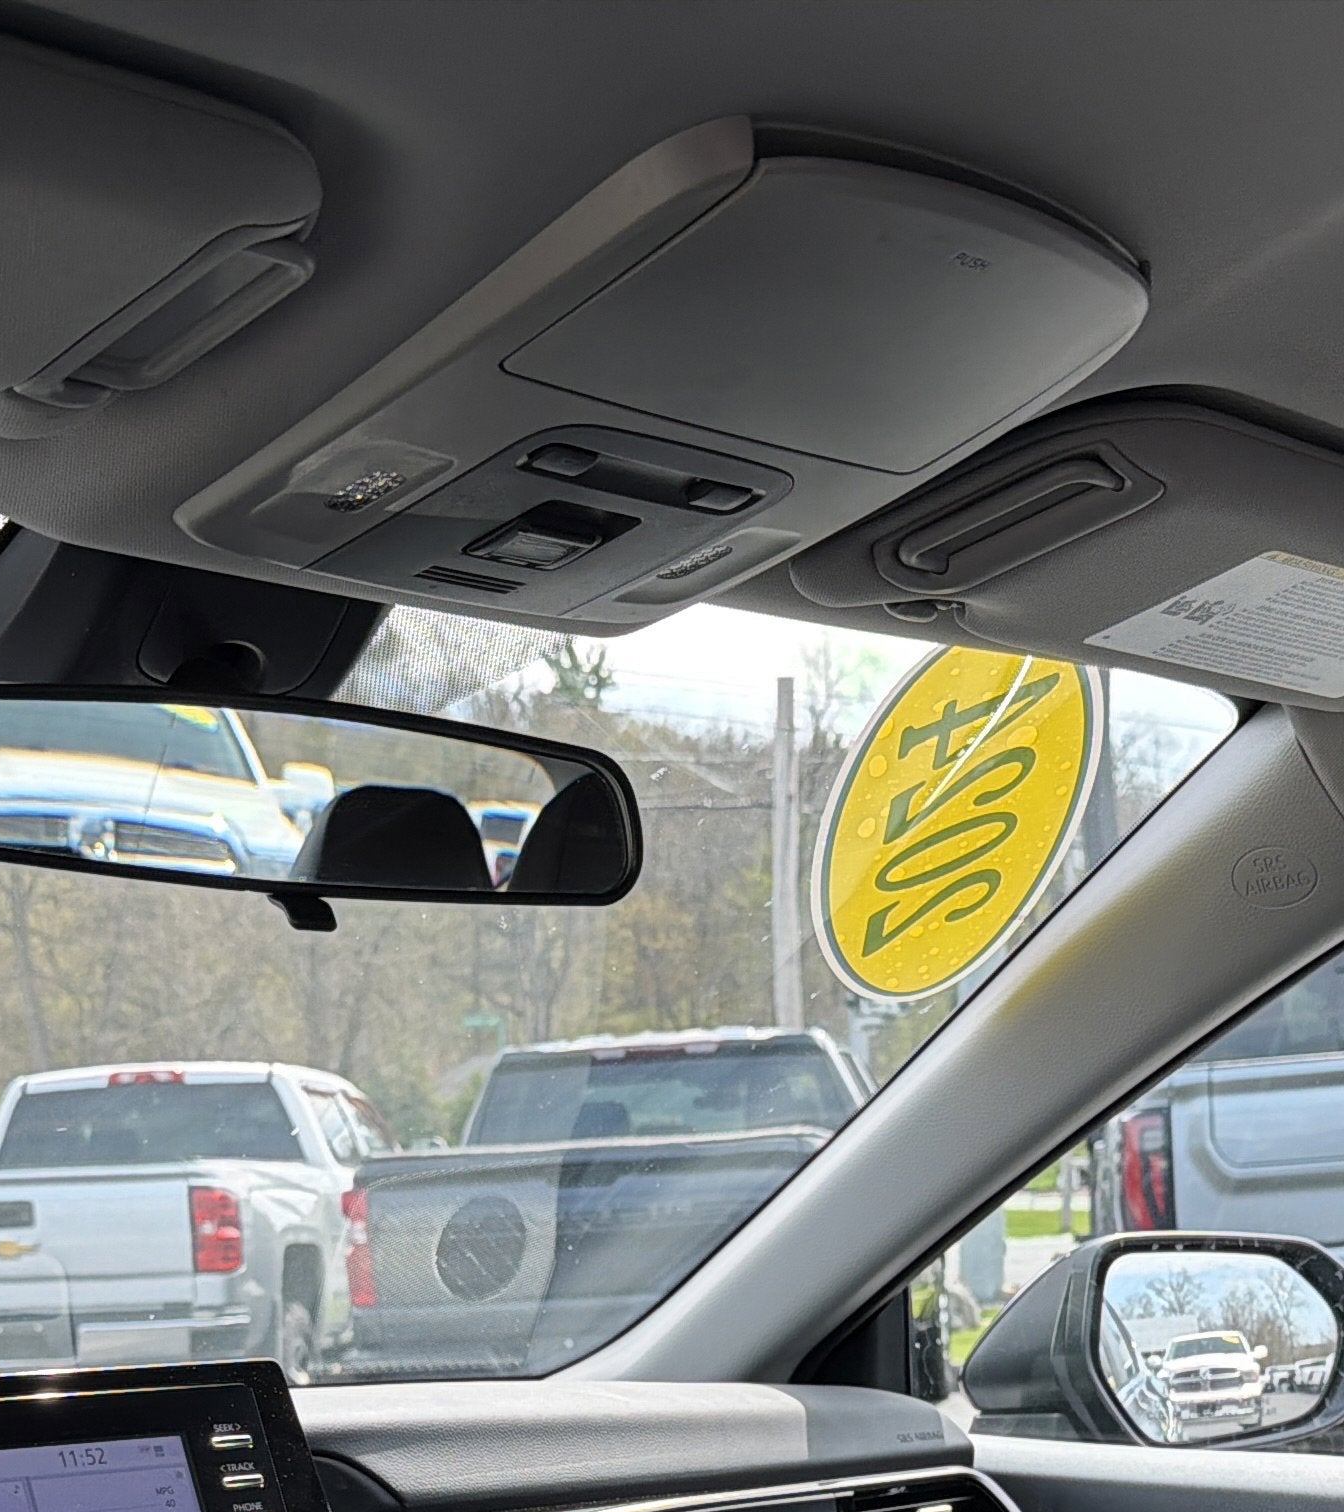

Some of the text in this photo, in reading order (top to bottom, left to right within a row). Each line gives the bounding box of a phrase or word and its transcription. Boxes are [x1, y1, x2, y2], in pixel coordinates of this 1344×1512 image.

[1246, 870, 1311, 897] AIRBAG
[58, 1447, 108, 1468] 11:52
[226, 1461, 256, 1472] TRACK
[233, 1502, 264, 1512] PHONE
